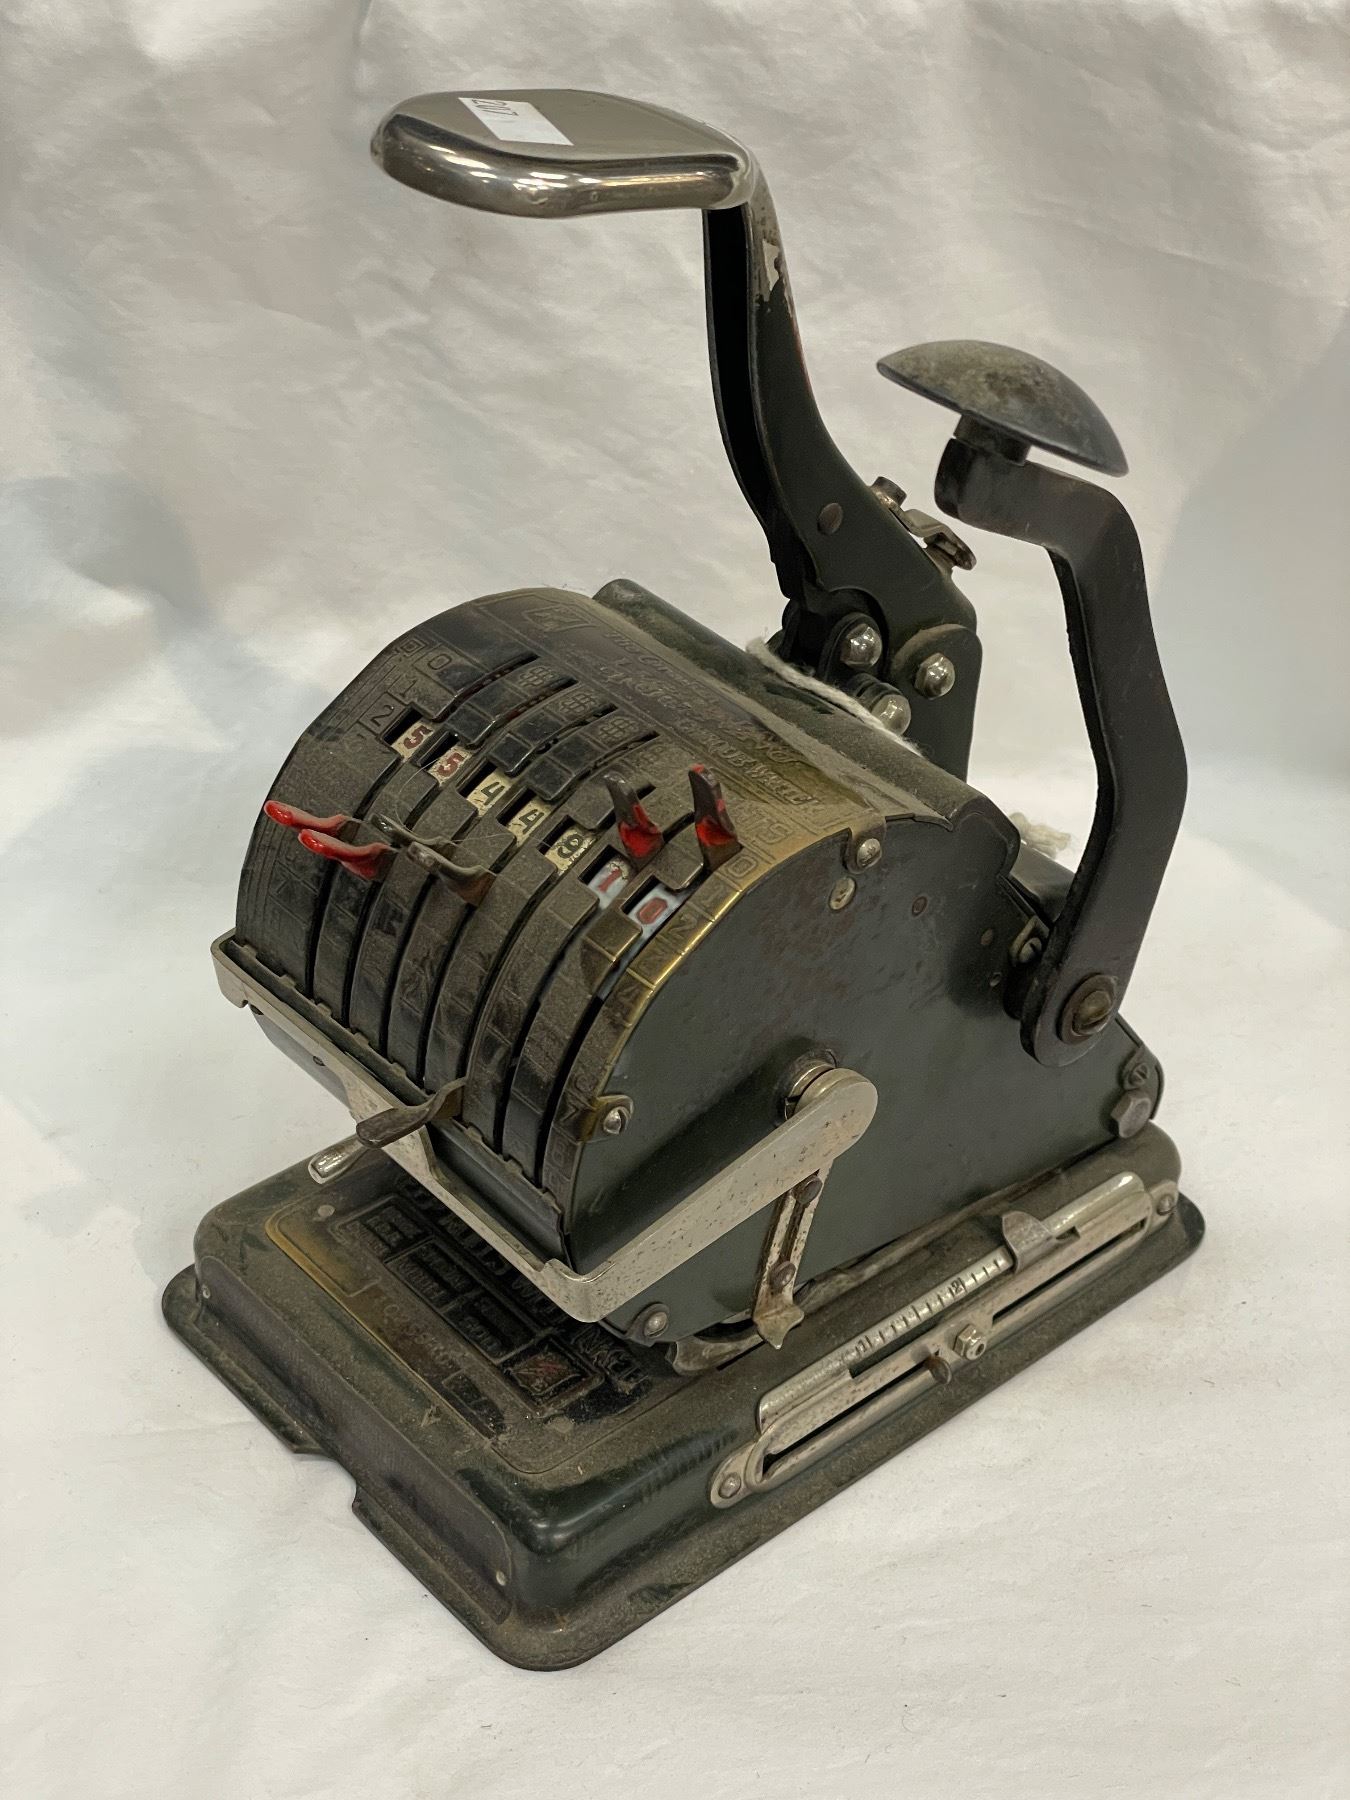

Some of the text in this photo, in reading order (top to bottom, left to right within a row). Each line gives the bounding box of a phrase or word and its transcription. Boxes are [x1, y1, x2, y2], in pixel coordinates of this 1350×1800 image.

[369, 703, 397, 728] 2
[403, 724, 434, 750] 5
[437, 751, 466, 778] 5
[480, 780, 506, 806] 4
[518, 807, 545, 834] 4
[636, 896, 669, 925] 0
[951, 1280, 963, 1293] 2
